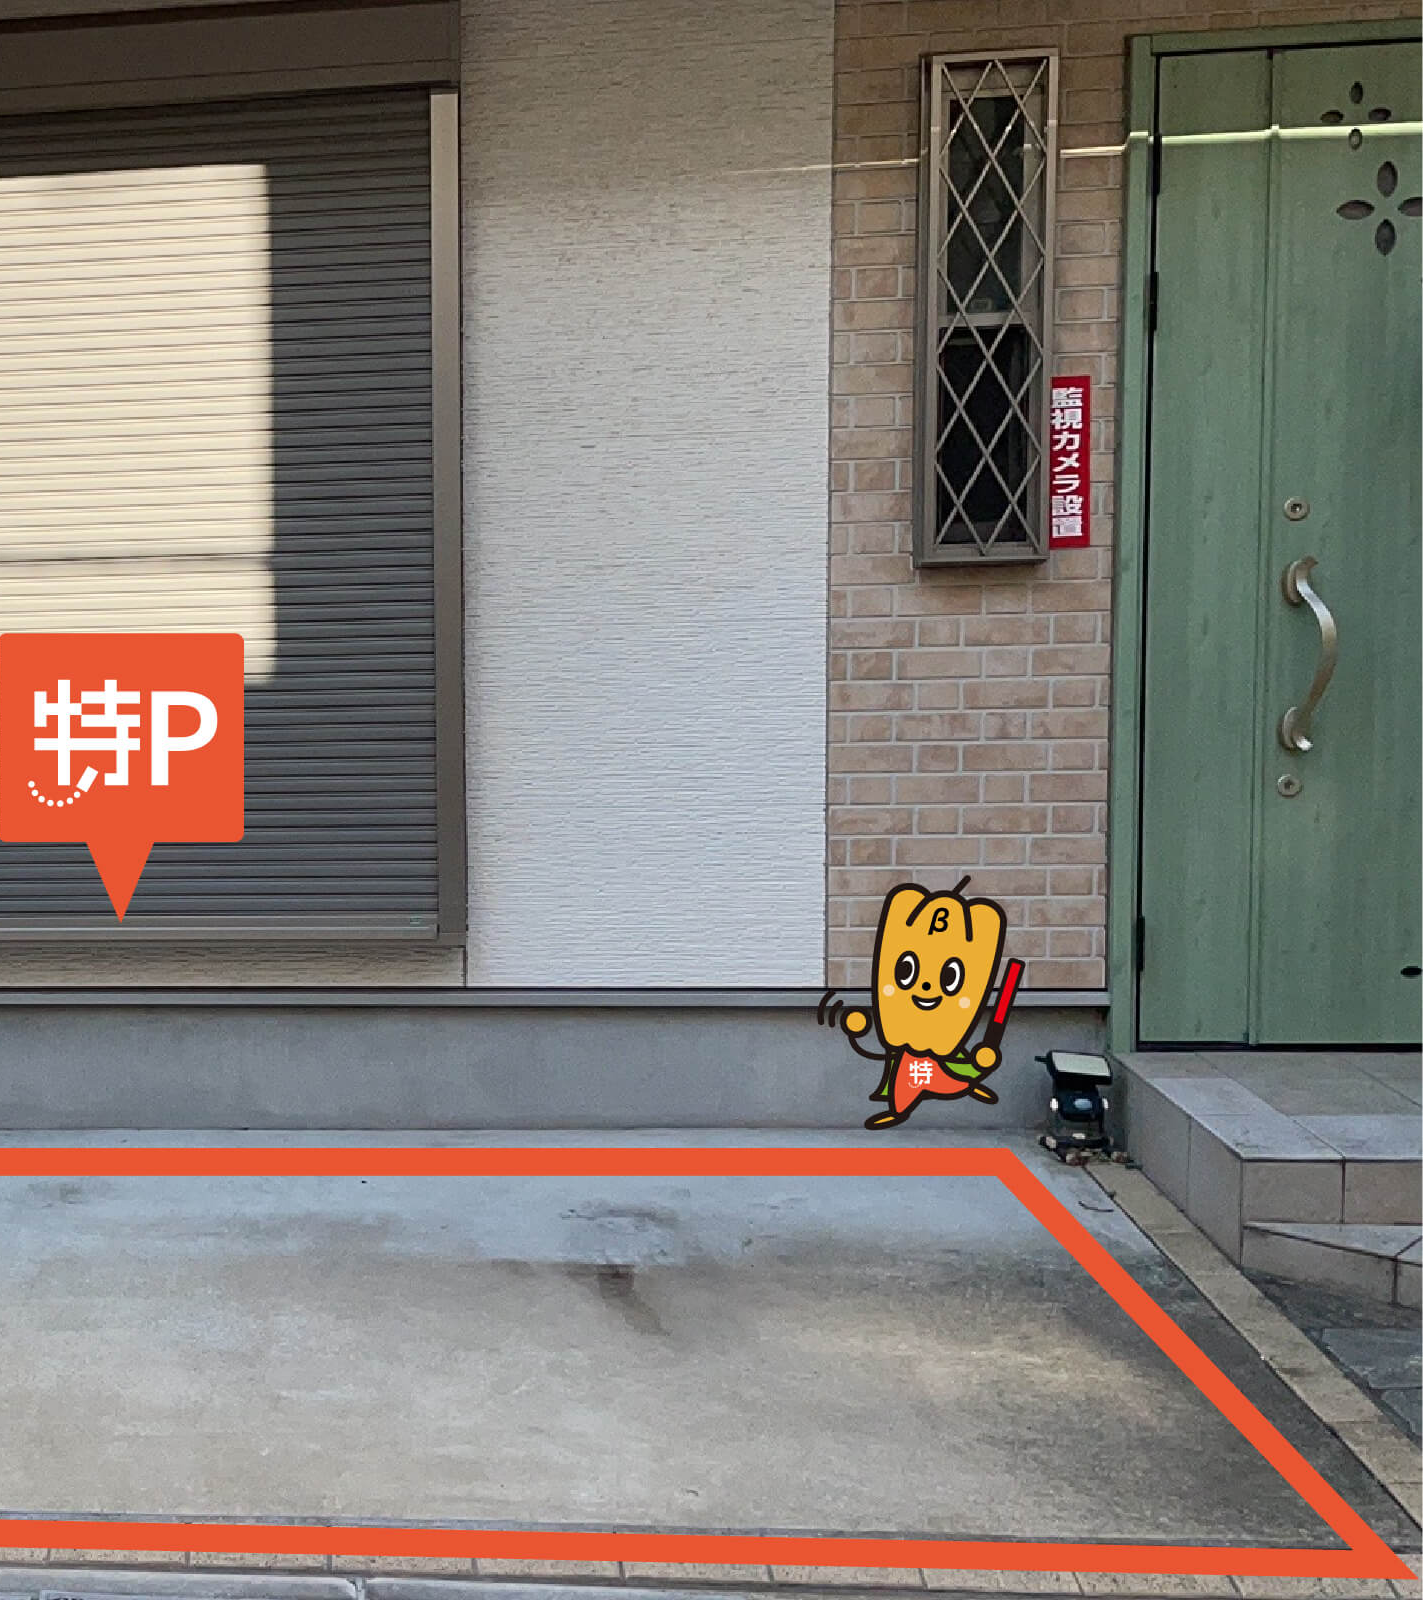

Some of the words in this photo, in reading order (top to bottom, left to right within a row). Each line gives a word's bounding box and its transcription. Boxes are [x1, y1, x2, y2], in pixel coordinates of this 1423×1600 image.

[1051, 387, 1083, 538] 監視カメラ設置
